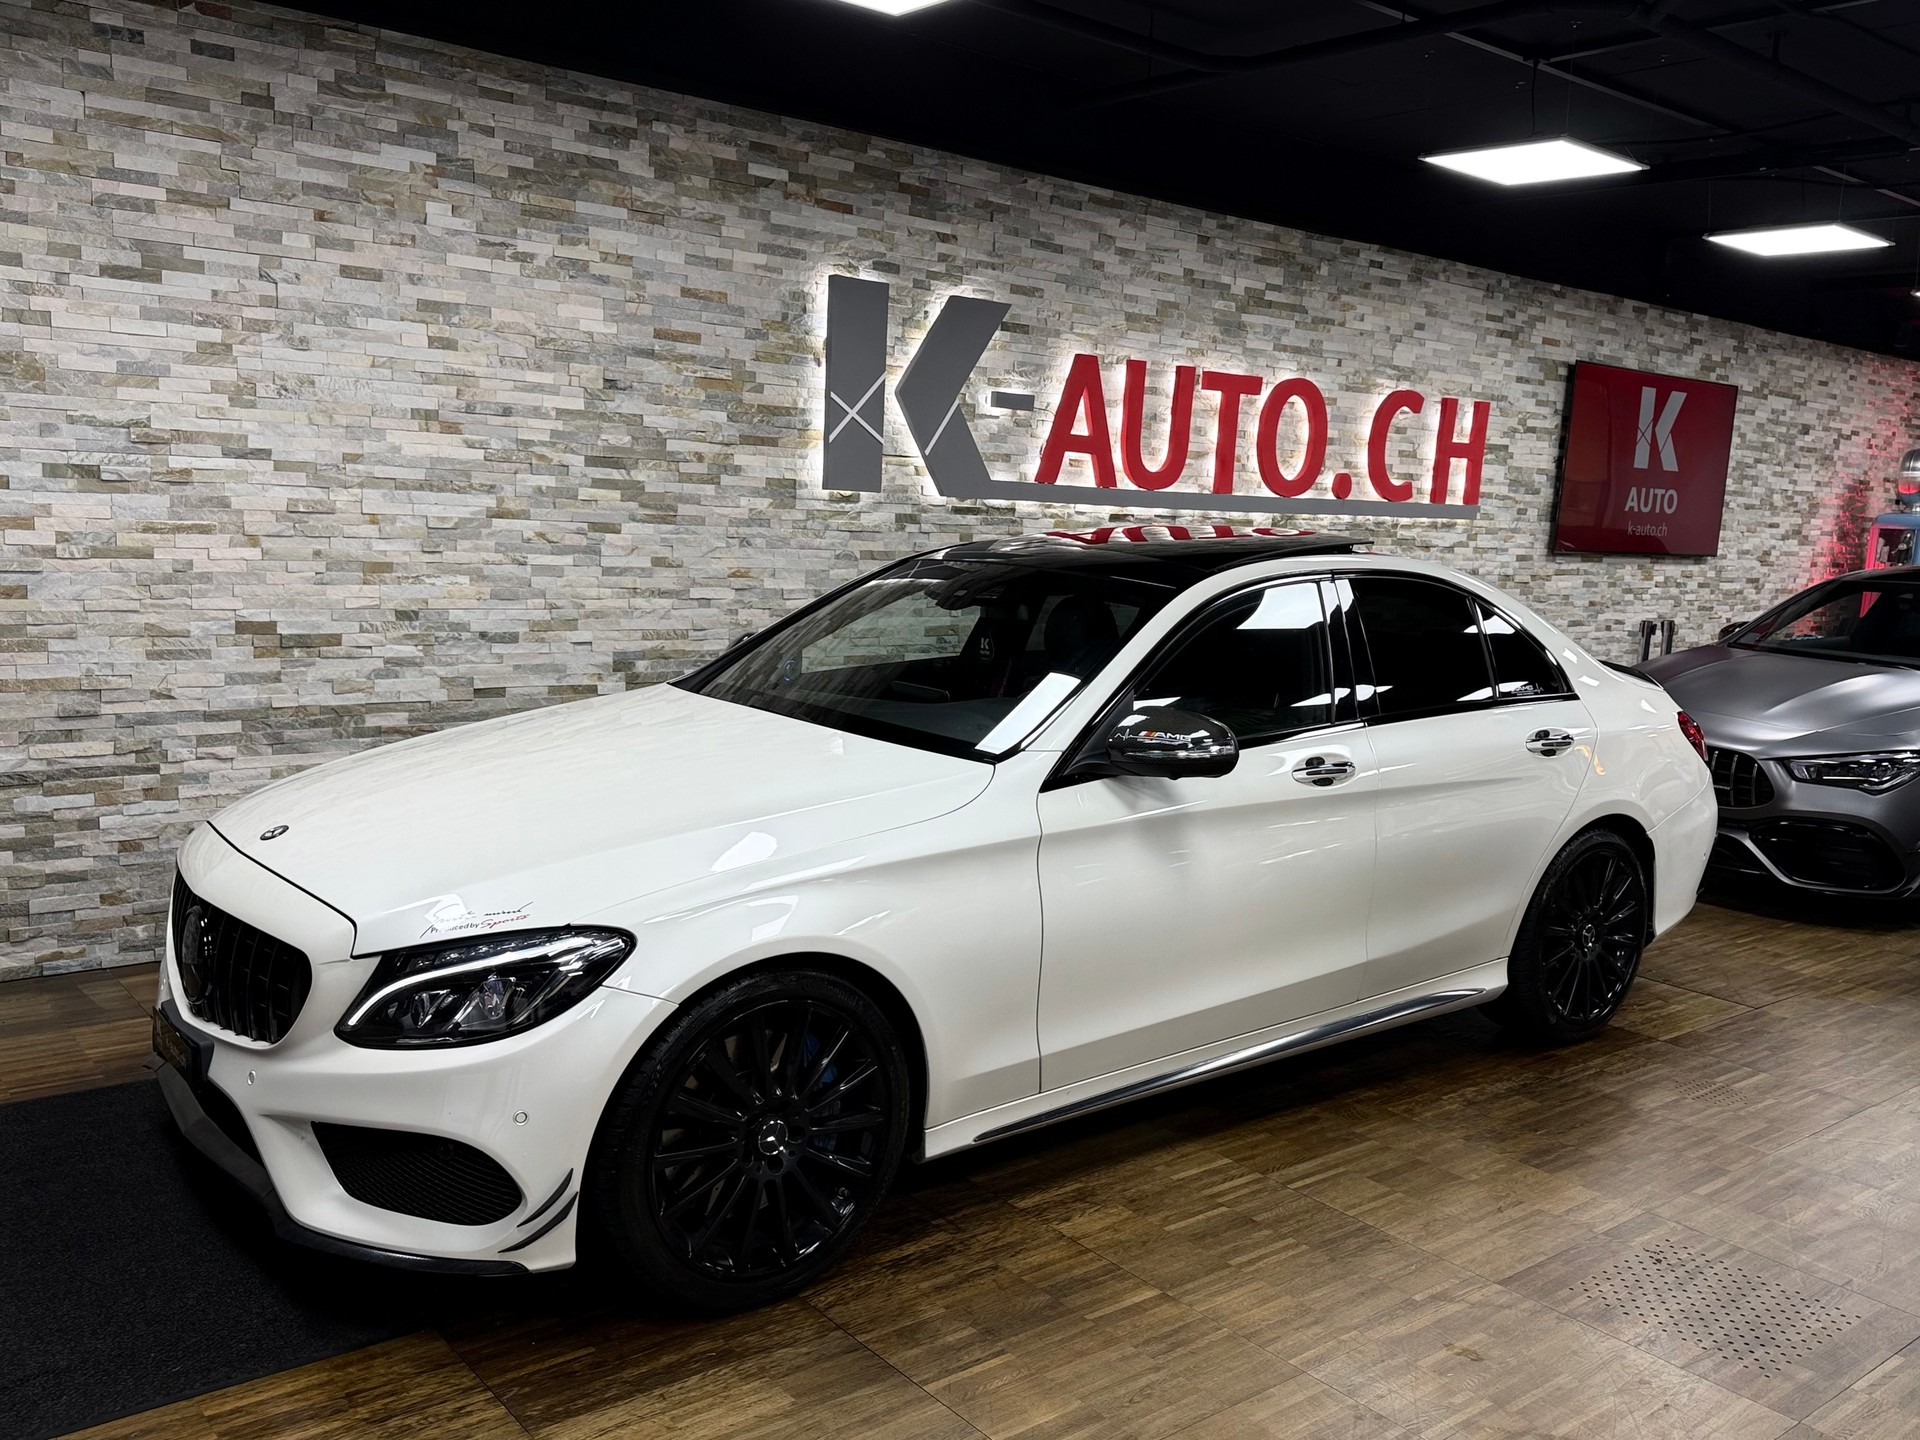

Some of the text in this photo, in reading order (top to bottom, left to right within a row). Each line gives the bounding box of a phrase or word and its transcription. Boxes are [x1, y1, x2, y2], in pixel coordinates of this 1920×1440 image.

[1634, 386, 1688, 472] K
[1624, 486, 1678, 514] AUTO
[1627, 520, 1668, 536] k-auto.ch
